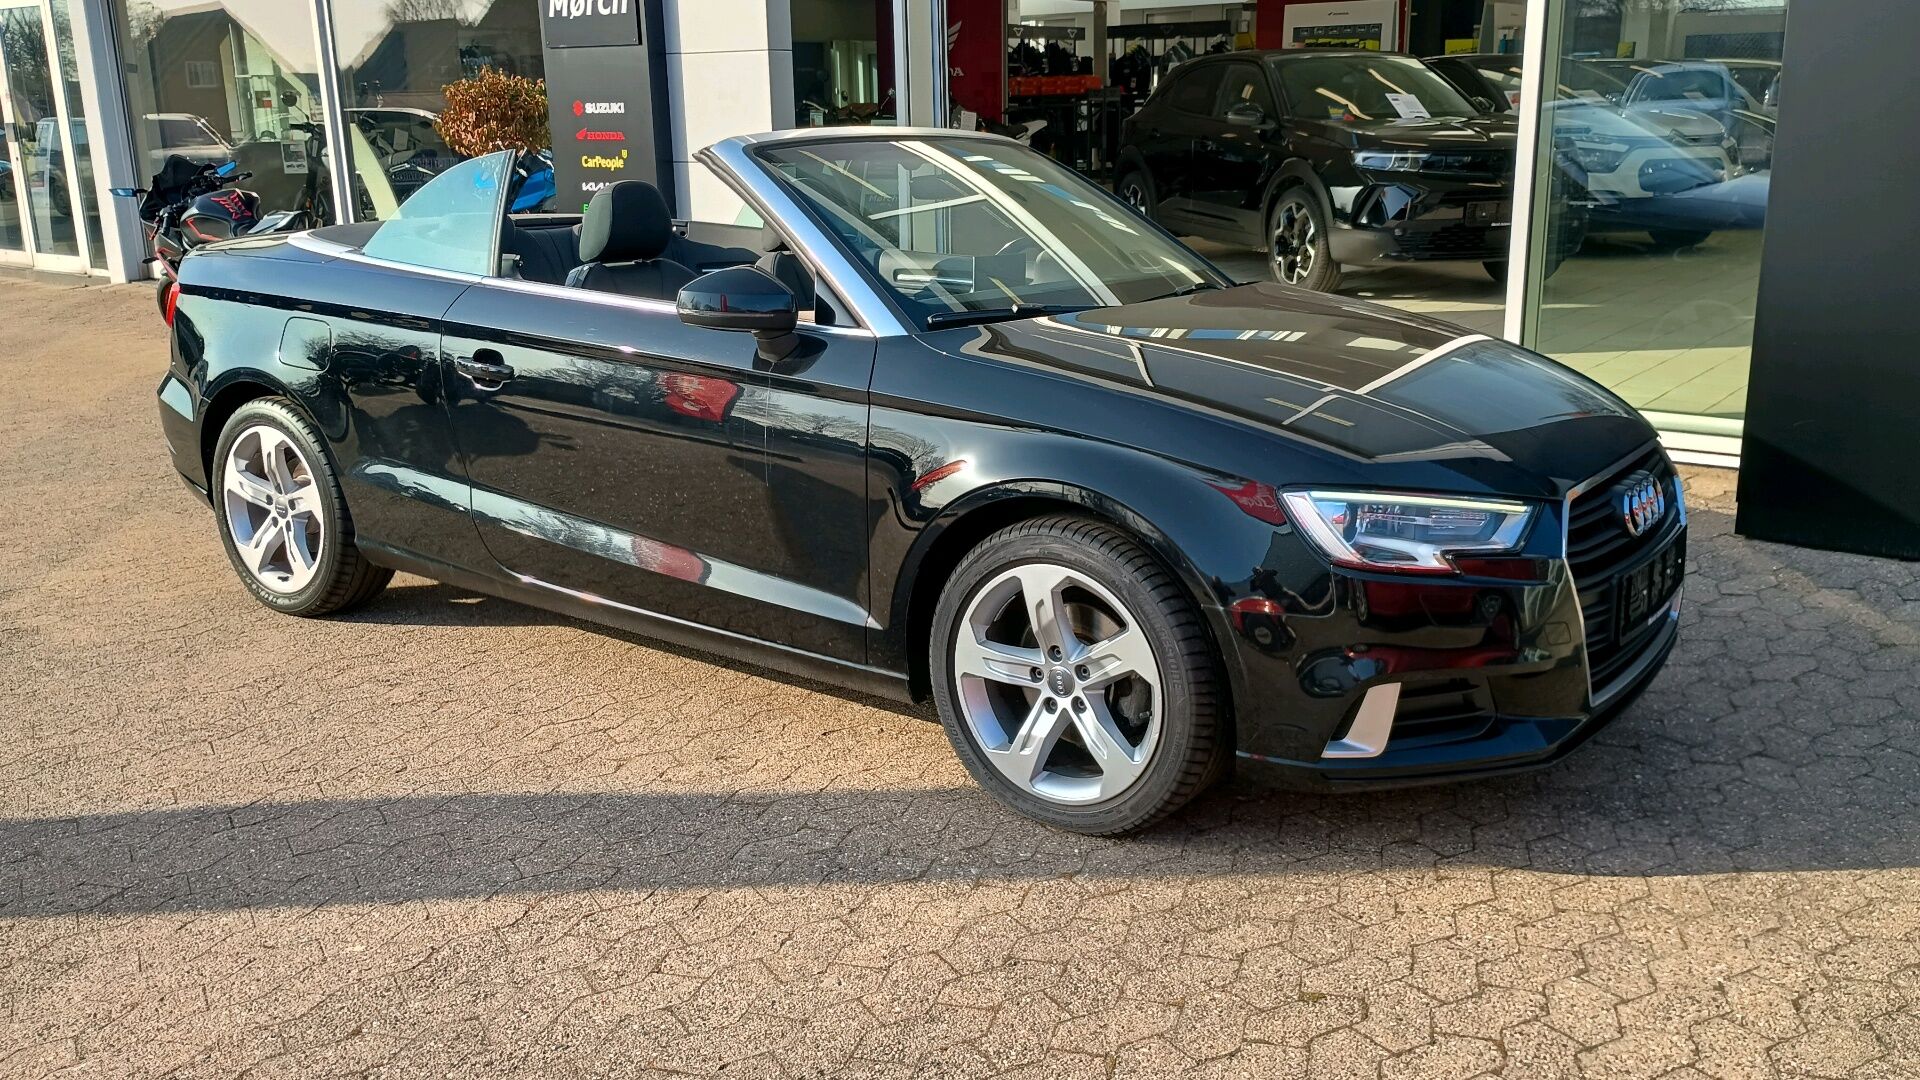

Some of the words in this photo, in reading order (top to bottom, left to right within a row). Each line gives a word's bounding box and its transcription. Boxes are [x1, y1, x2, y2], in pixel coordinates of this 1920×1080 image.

[585, 102, 625, 114] SUZUKI
[587, 131, 625, 140] HONDA
[581, 155, 625, 171] CarPeople
